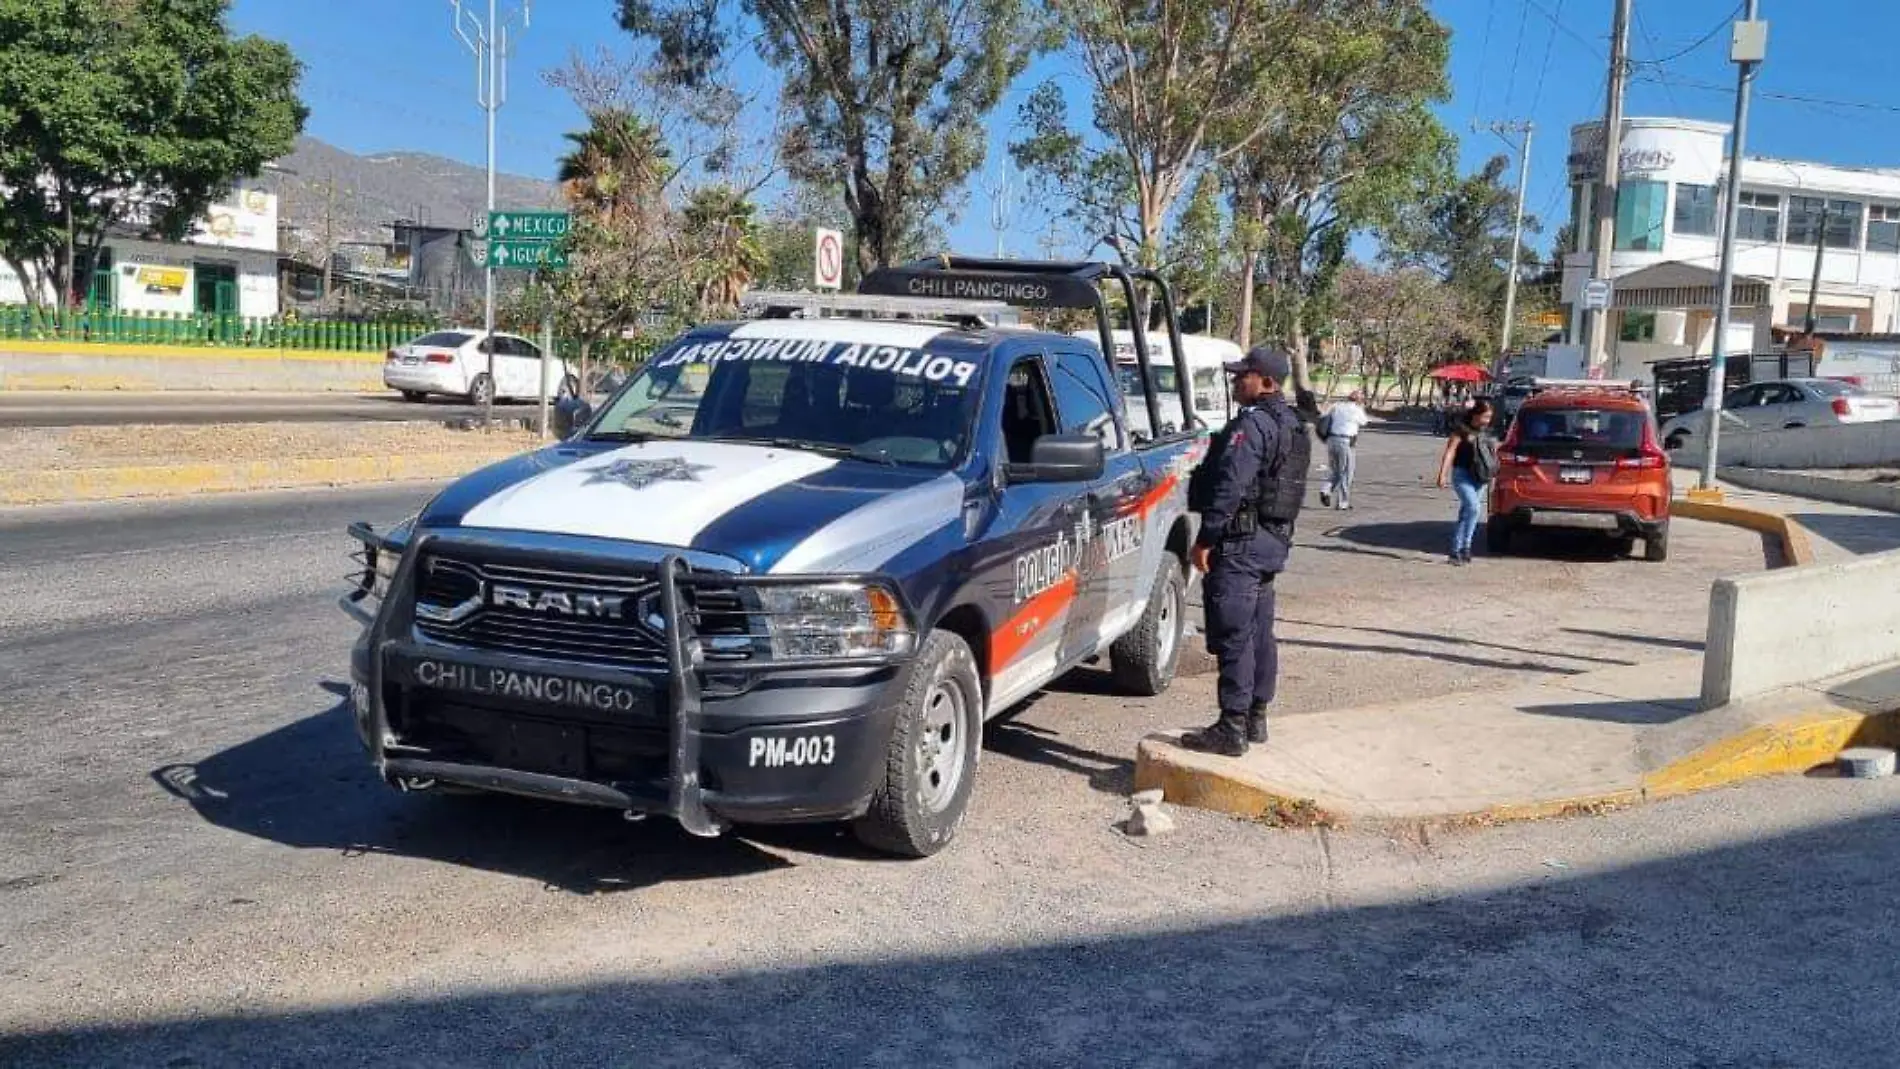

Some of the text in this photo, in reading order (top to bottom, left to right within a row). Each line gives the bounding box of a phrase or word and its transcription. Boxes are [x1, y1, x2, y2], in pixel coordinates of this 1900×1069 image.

[512, 216, 566, 234] MEXICO
[908, 277, 1048, 299] CHILPANCINGO
[493, 585, 624, 619] RAM
[416, 660, 634, 712] CHILPANCINGO
[748, 734, 836, 768] PM-003
